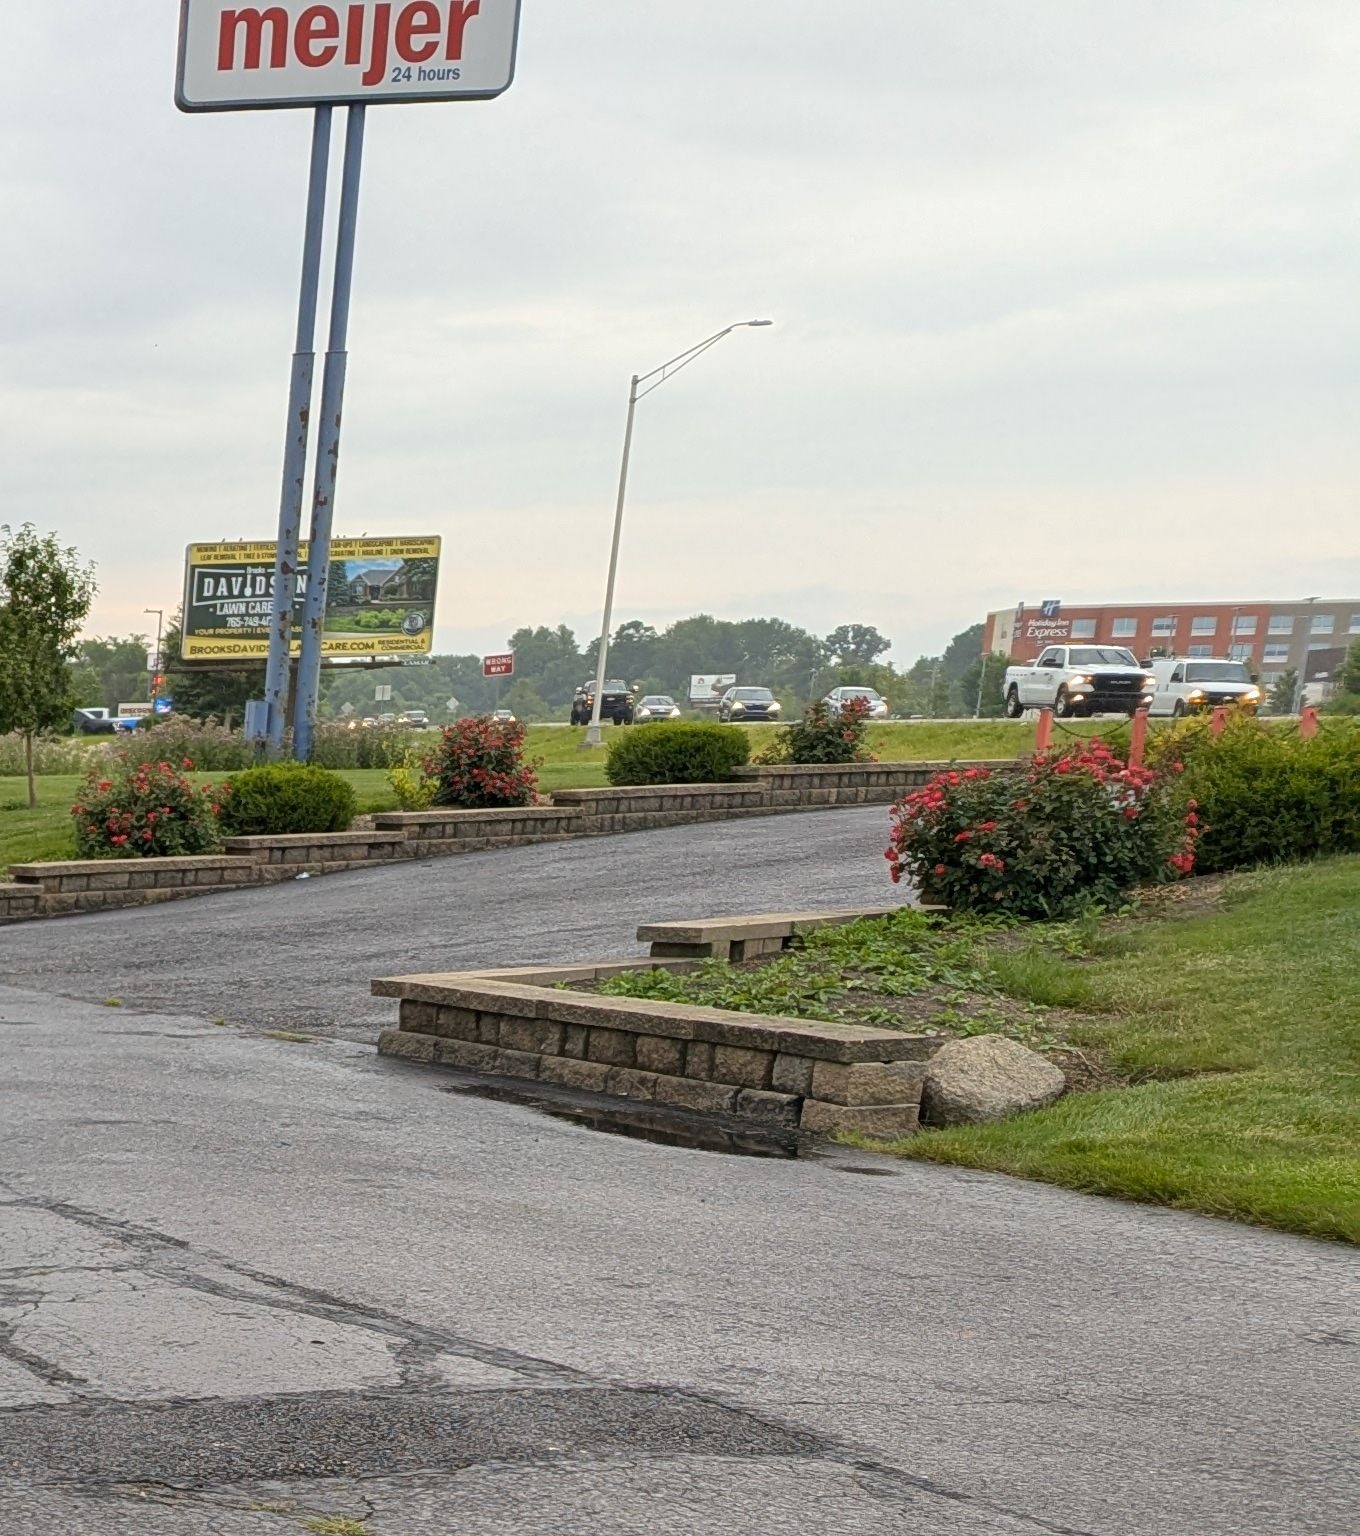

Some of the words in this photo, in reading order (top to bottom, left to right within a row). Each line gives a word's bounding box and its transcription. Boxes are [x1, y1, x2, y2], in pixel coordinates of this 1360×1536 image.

[217, 0, 479, 86] meijer
[391, 67, 412, 83] 24
[418, 66, 460, 82] hours
[203, 574, 308, 597] DAVIDSN
[216, 602, 246, 615] LAWN
[248, 601, 274, 614] CARE
[1027, 627, 1068, 639] Express
[490, 665, 506, 673] WAY
